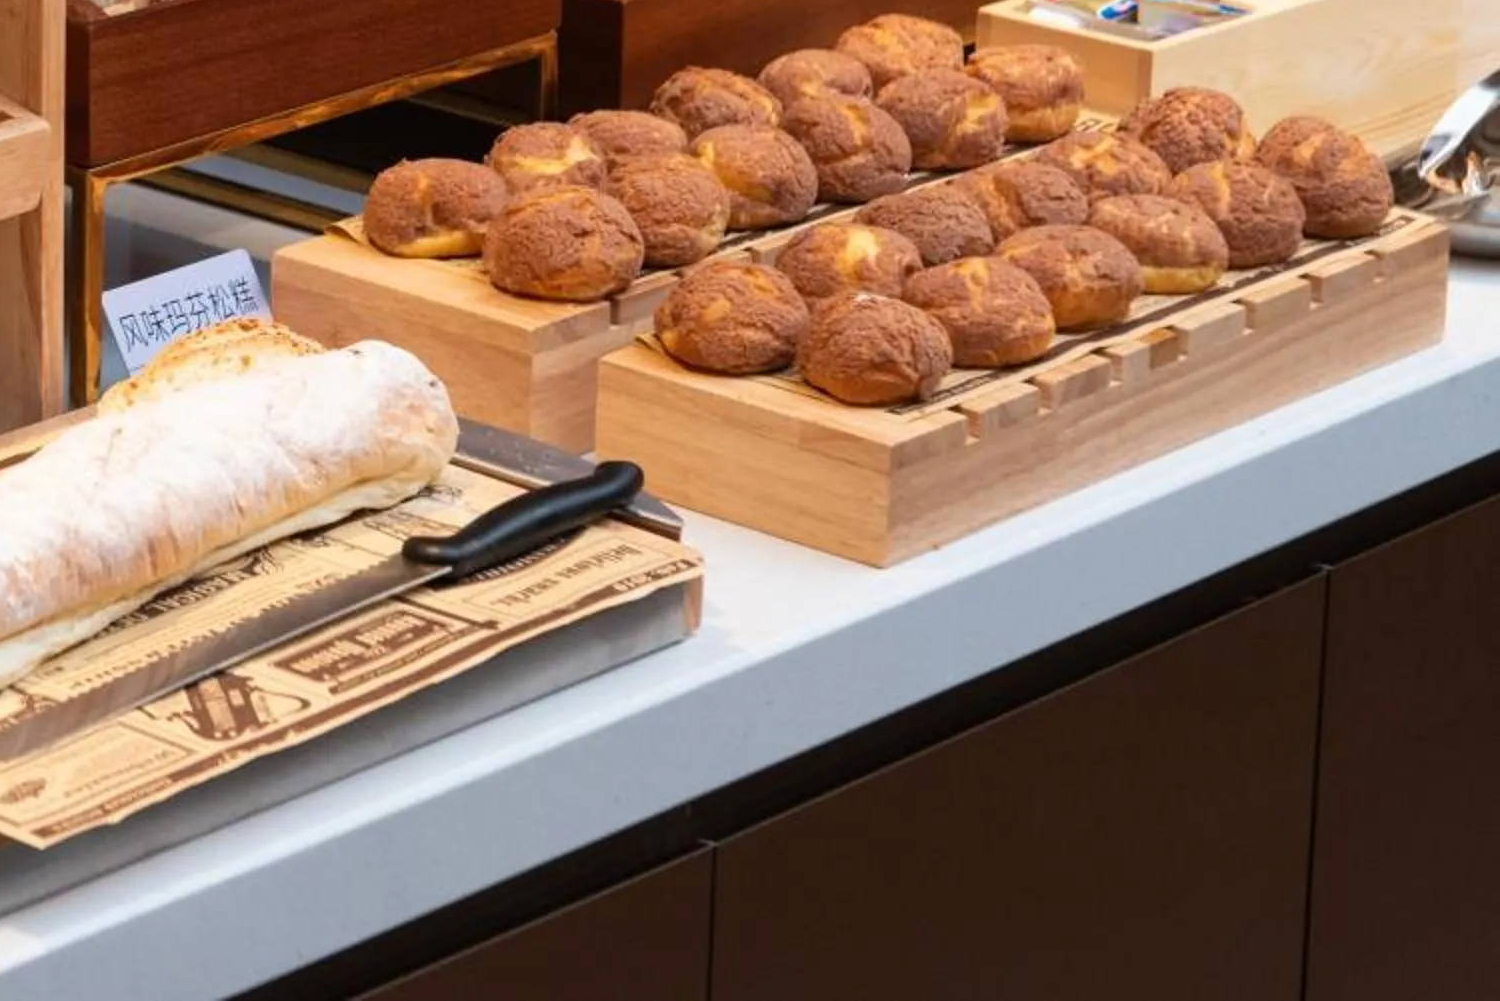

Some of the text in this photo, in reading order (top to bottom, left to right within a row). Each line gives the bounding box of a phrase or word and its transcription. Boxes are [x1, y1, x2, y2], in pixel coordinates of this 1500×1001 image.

[119, 276, 259, 352] 风味玛芬松糕
